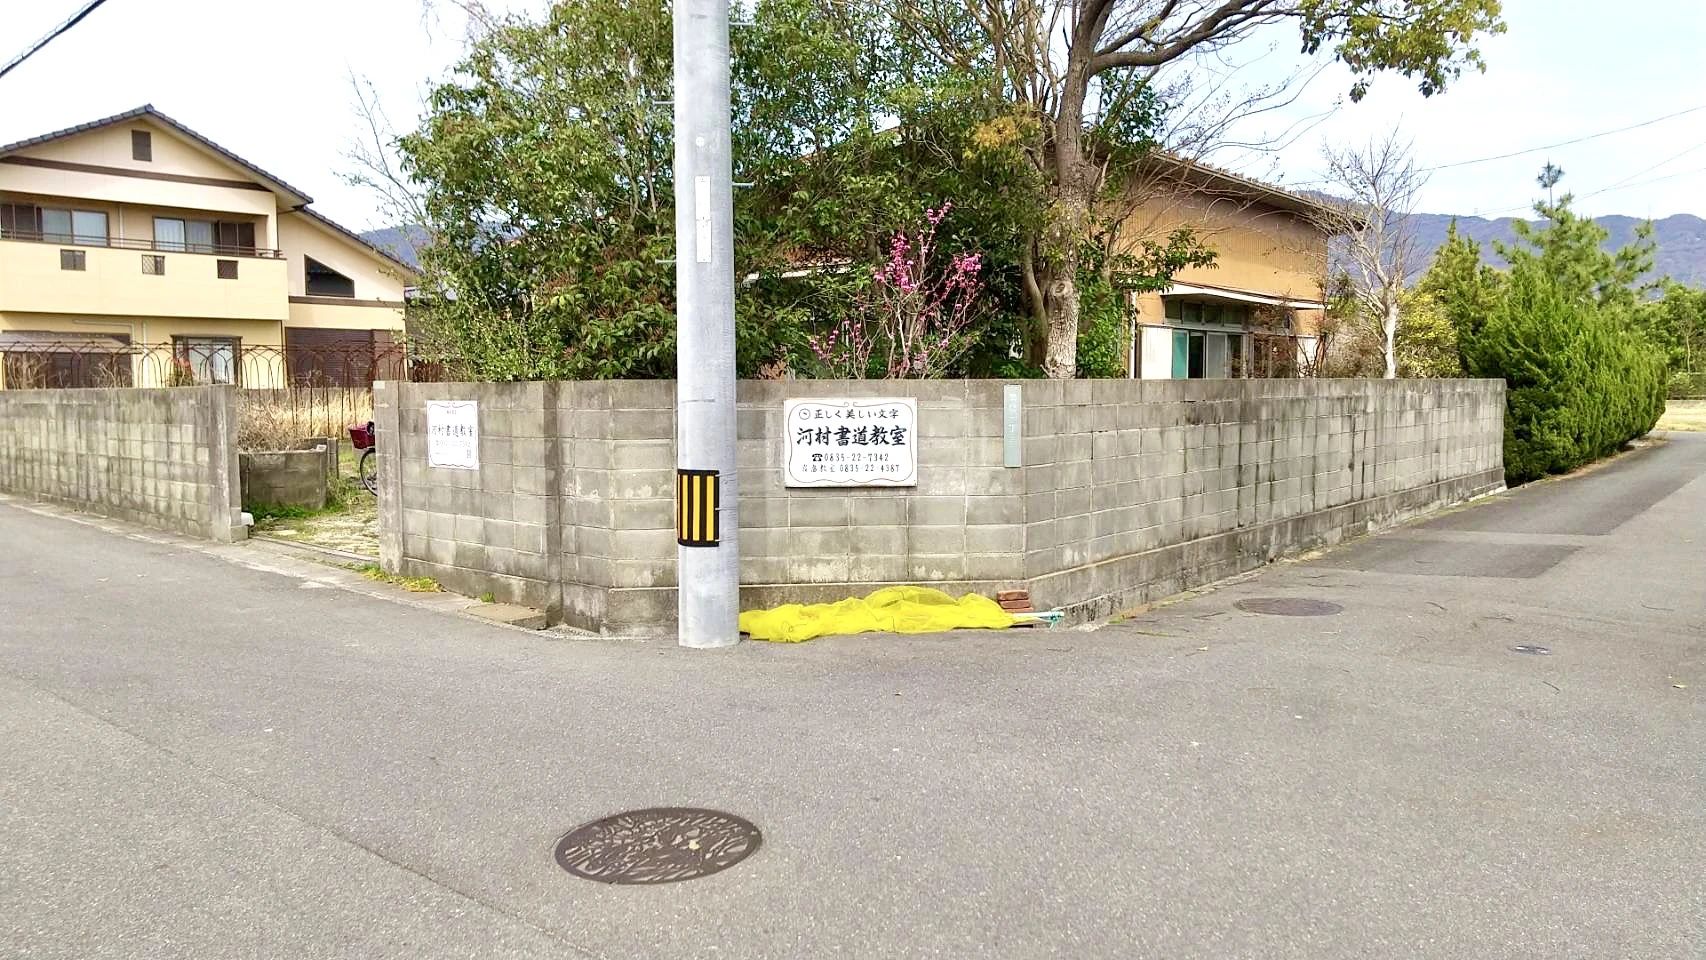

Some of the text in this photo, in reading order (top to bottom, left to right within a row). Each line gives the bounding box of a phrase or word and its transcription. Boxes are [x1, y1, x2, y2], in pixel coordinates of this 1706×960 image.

[814, 408, 899, 419] 正しく美しい文字
[796, 425, 907, 446] 河村書道教室
[824, 453, 889, 462] 0835-22-7342
